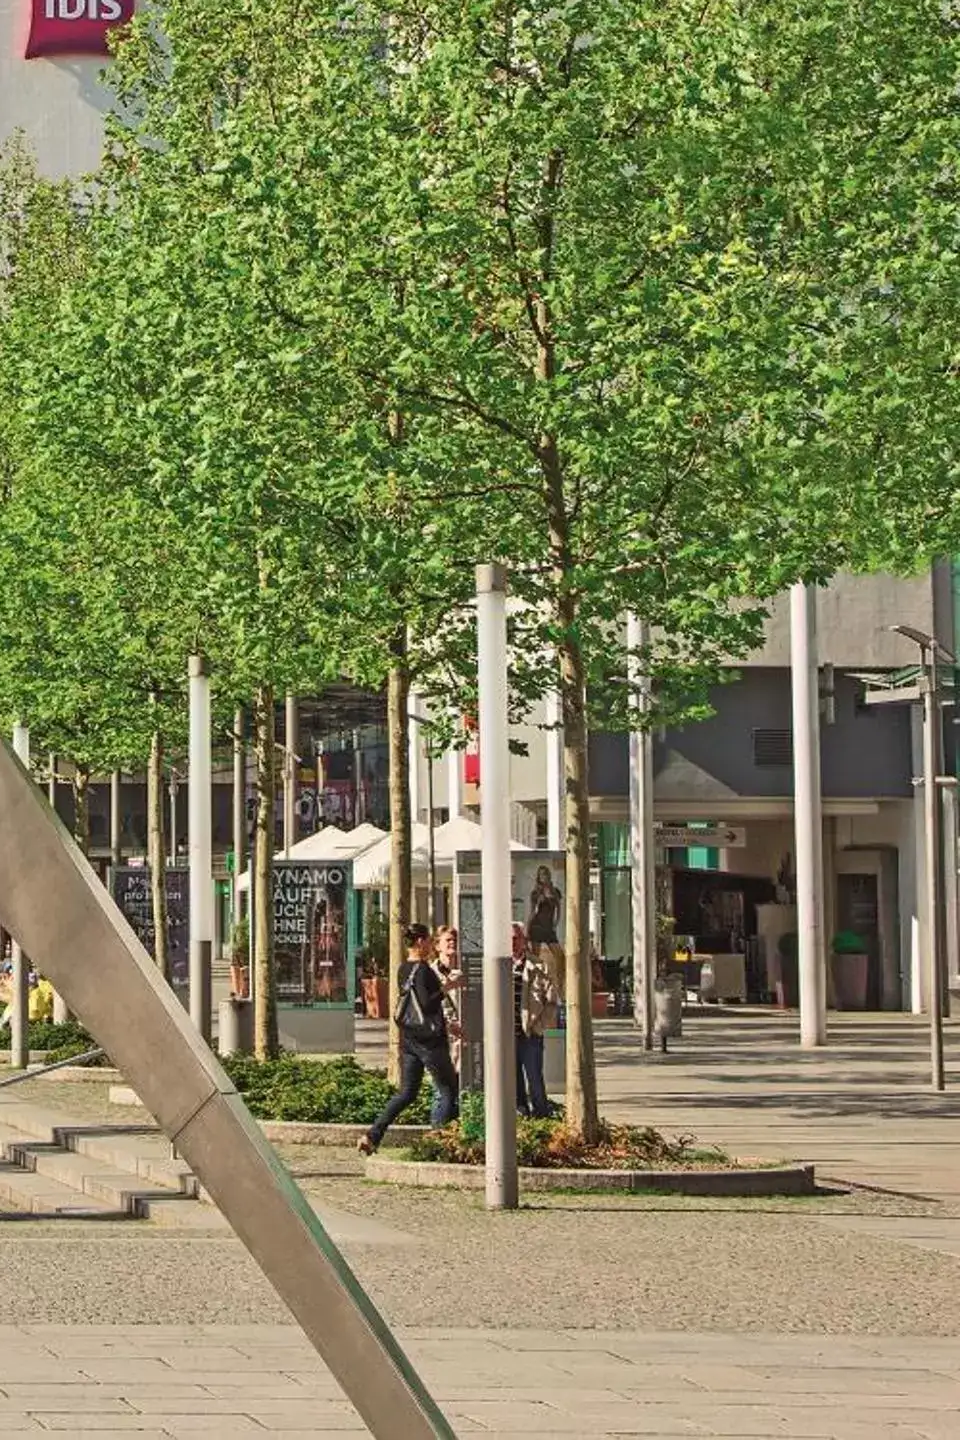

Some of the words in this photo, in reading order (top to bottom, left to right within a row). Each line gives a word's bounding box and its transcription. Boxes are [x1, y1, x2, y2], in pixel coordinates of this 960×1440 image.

[272, 869, 343, 884] YNAMO
[273, 884, 324, 902] ÄUFT
[273, 904, 306, 917] UCH
[273, 919, 306, 932] HNE
